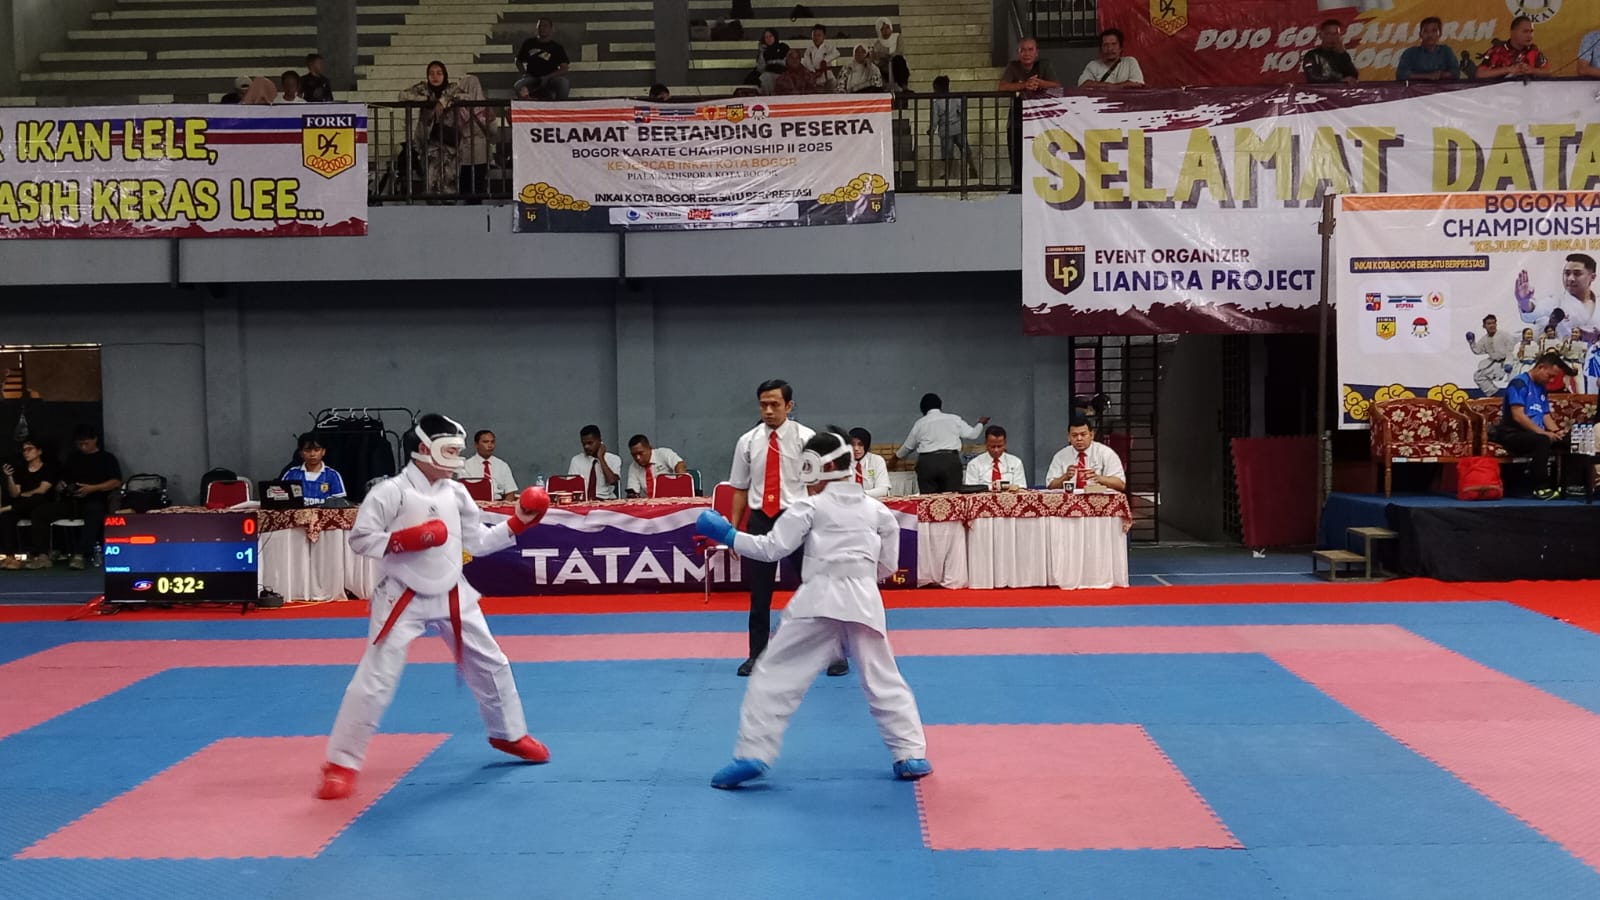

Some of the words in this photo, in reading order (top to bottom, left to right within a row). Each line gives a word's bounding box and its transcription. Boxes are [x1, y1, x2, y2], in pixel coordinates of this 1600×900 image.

[1195, 28, 1271, 51] DOJO
[1277, 26, 1322, 48] GO
[1342, 19, 1497, 44] PAJAJRAN
[306, 116, 352, 127] FORKI
[530, 126, 629, 144] SELAMAT
[637, 122, 772, 142] BERTANDING
[781, 118, 874, 138] PESERTA
[17, 120, 112, 162] IKAN
[123, 117, 218, 164] LELE,
[572, 148, 619, 159] BOGOR
[623, 146, 676, 158] KARATE
[679, 145, 784, 157] CHAMPIONSHIP
[798, 142, 833, 153] 2025
[717, 159, 749, 169] KOTA
[752, 157, 797, 168] BOGOR
[1032, 126, 1404, 211] SELAMAT
[93, 179, 220, 222] KERAS
[595, 194, 623, 203] INKAI
[625, 193, 653, 203] KOTA
[656, 193, 696, 203] BOGOR
[1485, 193, 1566, 213] BOGOR
[1443, 216, 1600, 237] CHAMPIONSH
[1095, 250, 1146, 265] EVENT
[1151, 249, 1250, 263] ORGANIZER
[1093, 271, 1204, 292] LIANDRA
[1211, 269, 1316, 290] PROJECT
[105, 517, 126, 526] AKA
[244, 519, 255, 535] 0
[105, 546, 120, 555] AO
[522, 545, 742, 586] TATAMI
